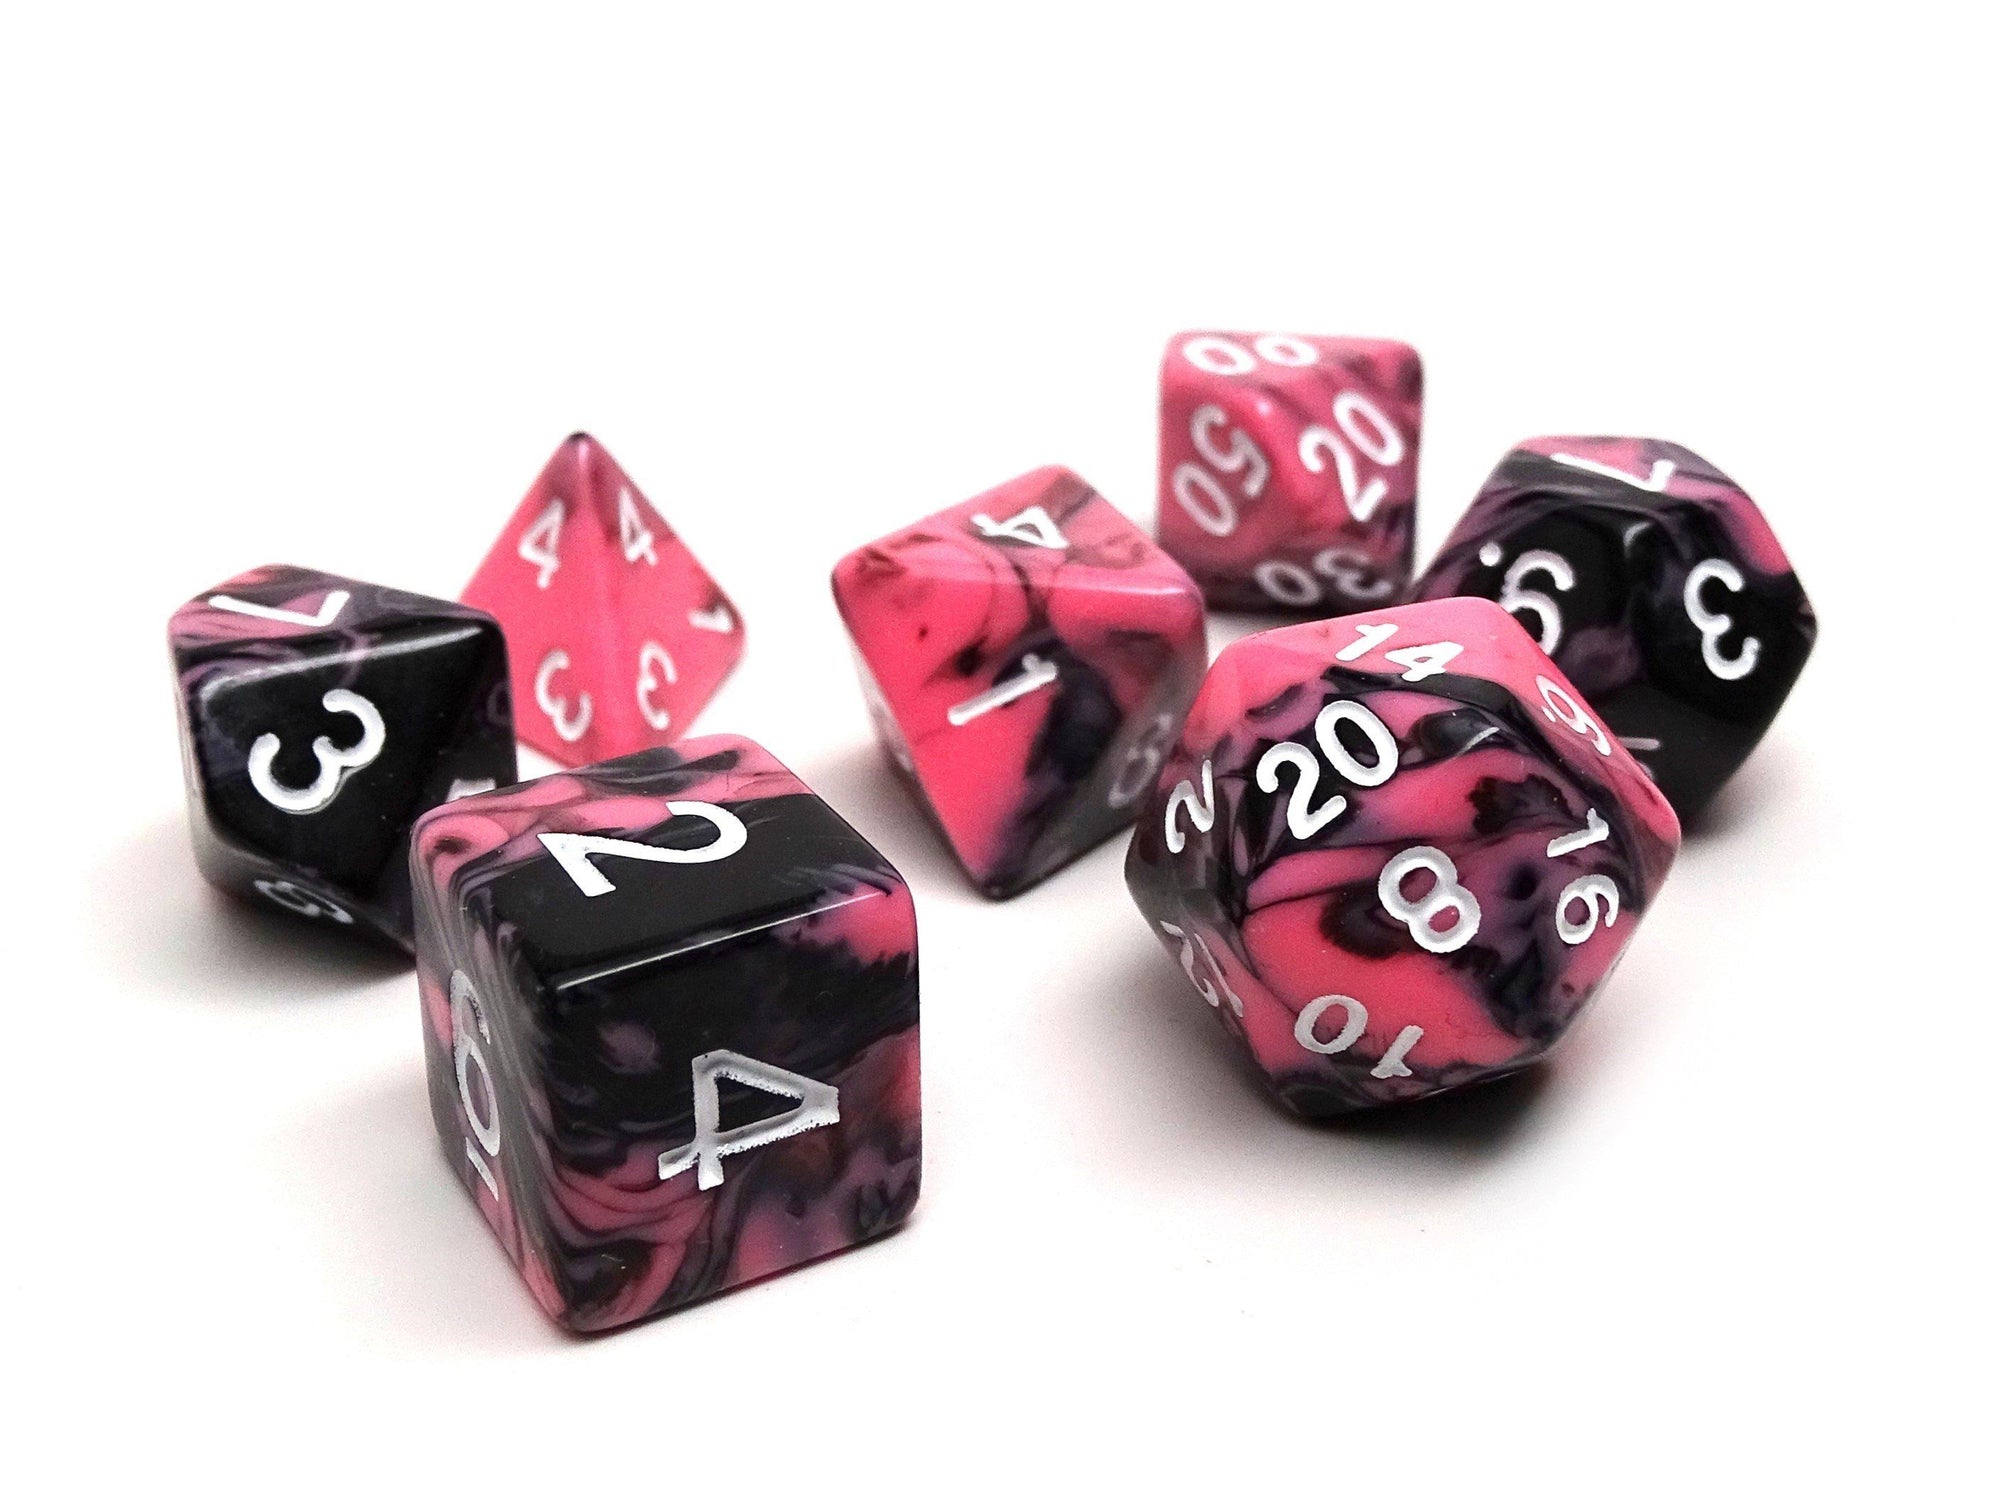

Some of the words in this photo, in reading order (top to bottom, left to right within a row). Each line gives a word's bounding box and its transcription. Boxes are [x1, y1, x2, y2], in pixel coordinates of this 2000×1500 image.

[1183, 337, 1319, 376] 00
[1172, 404, 1270, 537] 50
[1299, 391, 1404, 522] 20
[518, 499, 566, 588] 4
[617, 487, 658, 567] 4
[974, 506, 1069, 549] 4
[1335, 623, 1464, 682] 14
[1684, 558, 1761, 680] 3
[534, 651, 592, 740] 3
[636, 641, 677, 730] 3
[948, 653, 1058, 726] 1
[248, 689, 386, 815] 3
[1256, 699, 1399, 840] 20
[536, 800, 748, 898] 2
[1164, 759, 1215, 854] 2
[1378, 845, 1482, 954] 8
[1547, 807, 1619, 945] 16
[1294, 993, 1424, 1079] 10
[658, 1048, 841, 1191] 4
